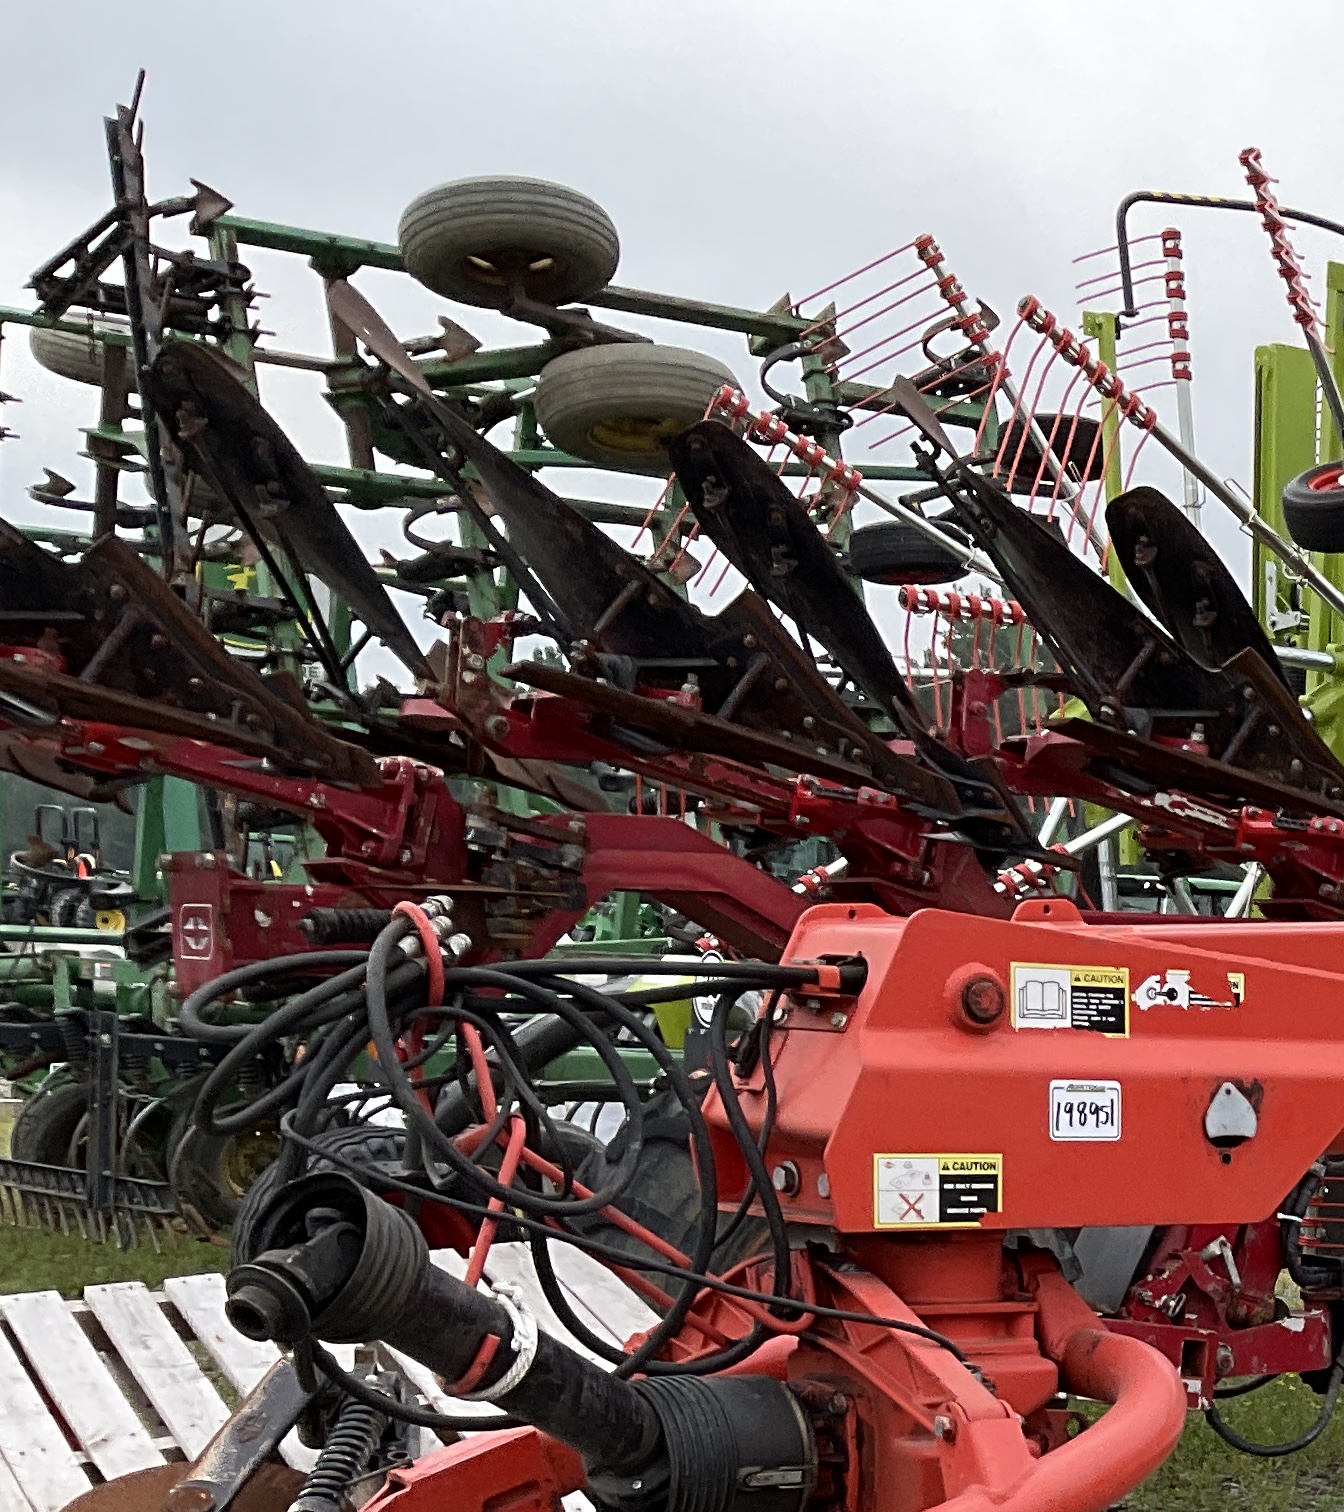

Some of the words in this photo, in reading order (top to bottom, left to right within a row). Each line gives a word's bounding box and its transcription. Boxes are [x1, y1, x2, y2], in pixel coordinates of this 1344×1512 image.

[1083, 974, 1124, 984] CAUTION
[1055, 1098, 1115, 1132] 198951
[952, 1161, 997, 1171] CAUTION
